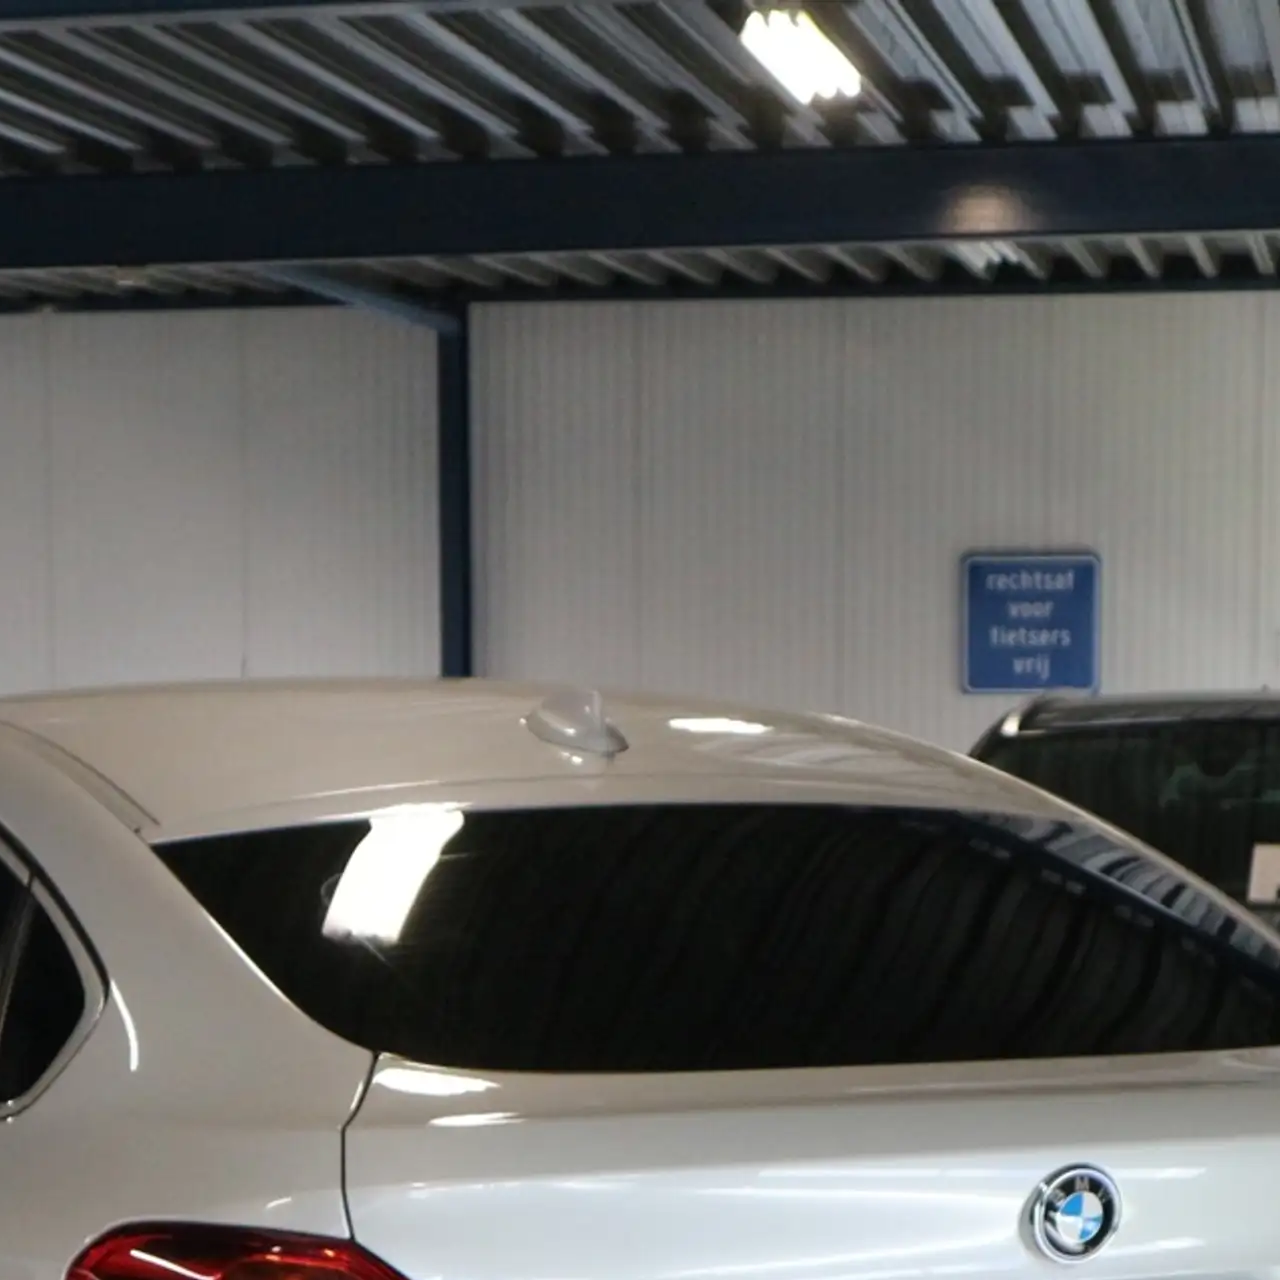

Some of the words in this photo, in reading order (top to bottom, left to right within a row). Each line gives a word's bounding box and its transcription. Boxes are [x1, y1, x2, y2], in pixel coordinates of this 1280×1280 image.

[985, 569, 1075, 591] rechtsaf
[1006, 601, 1055, 619] voor
[988, 625, 1072, 647] fietsers
[1013, 654, 1051, 682] vrij
